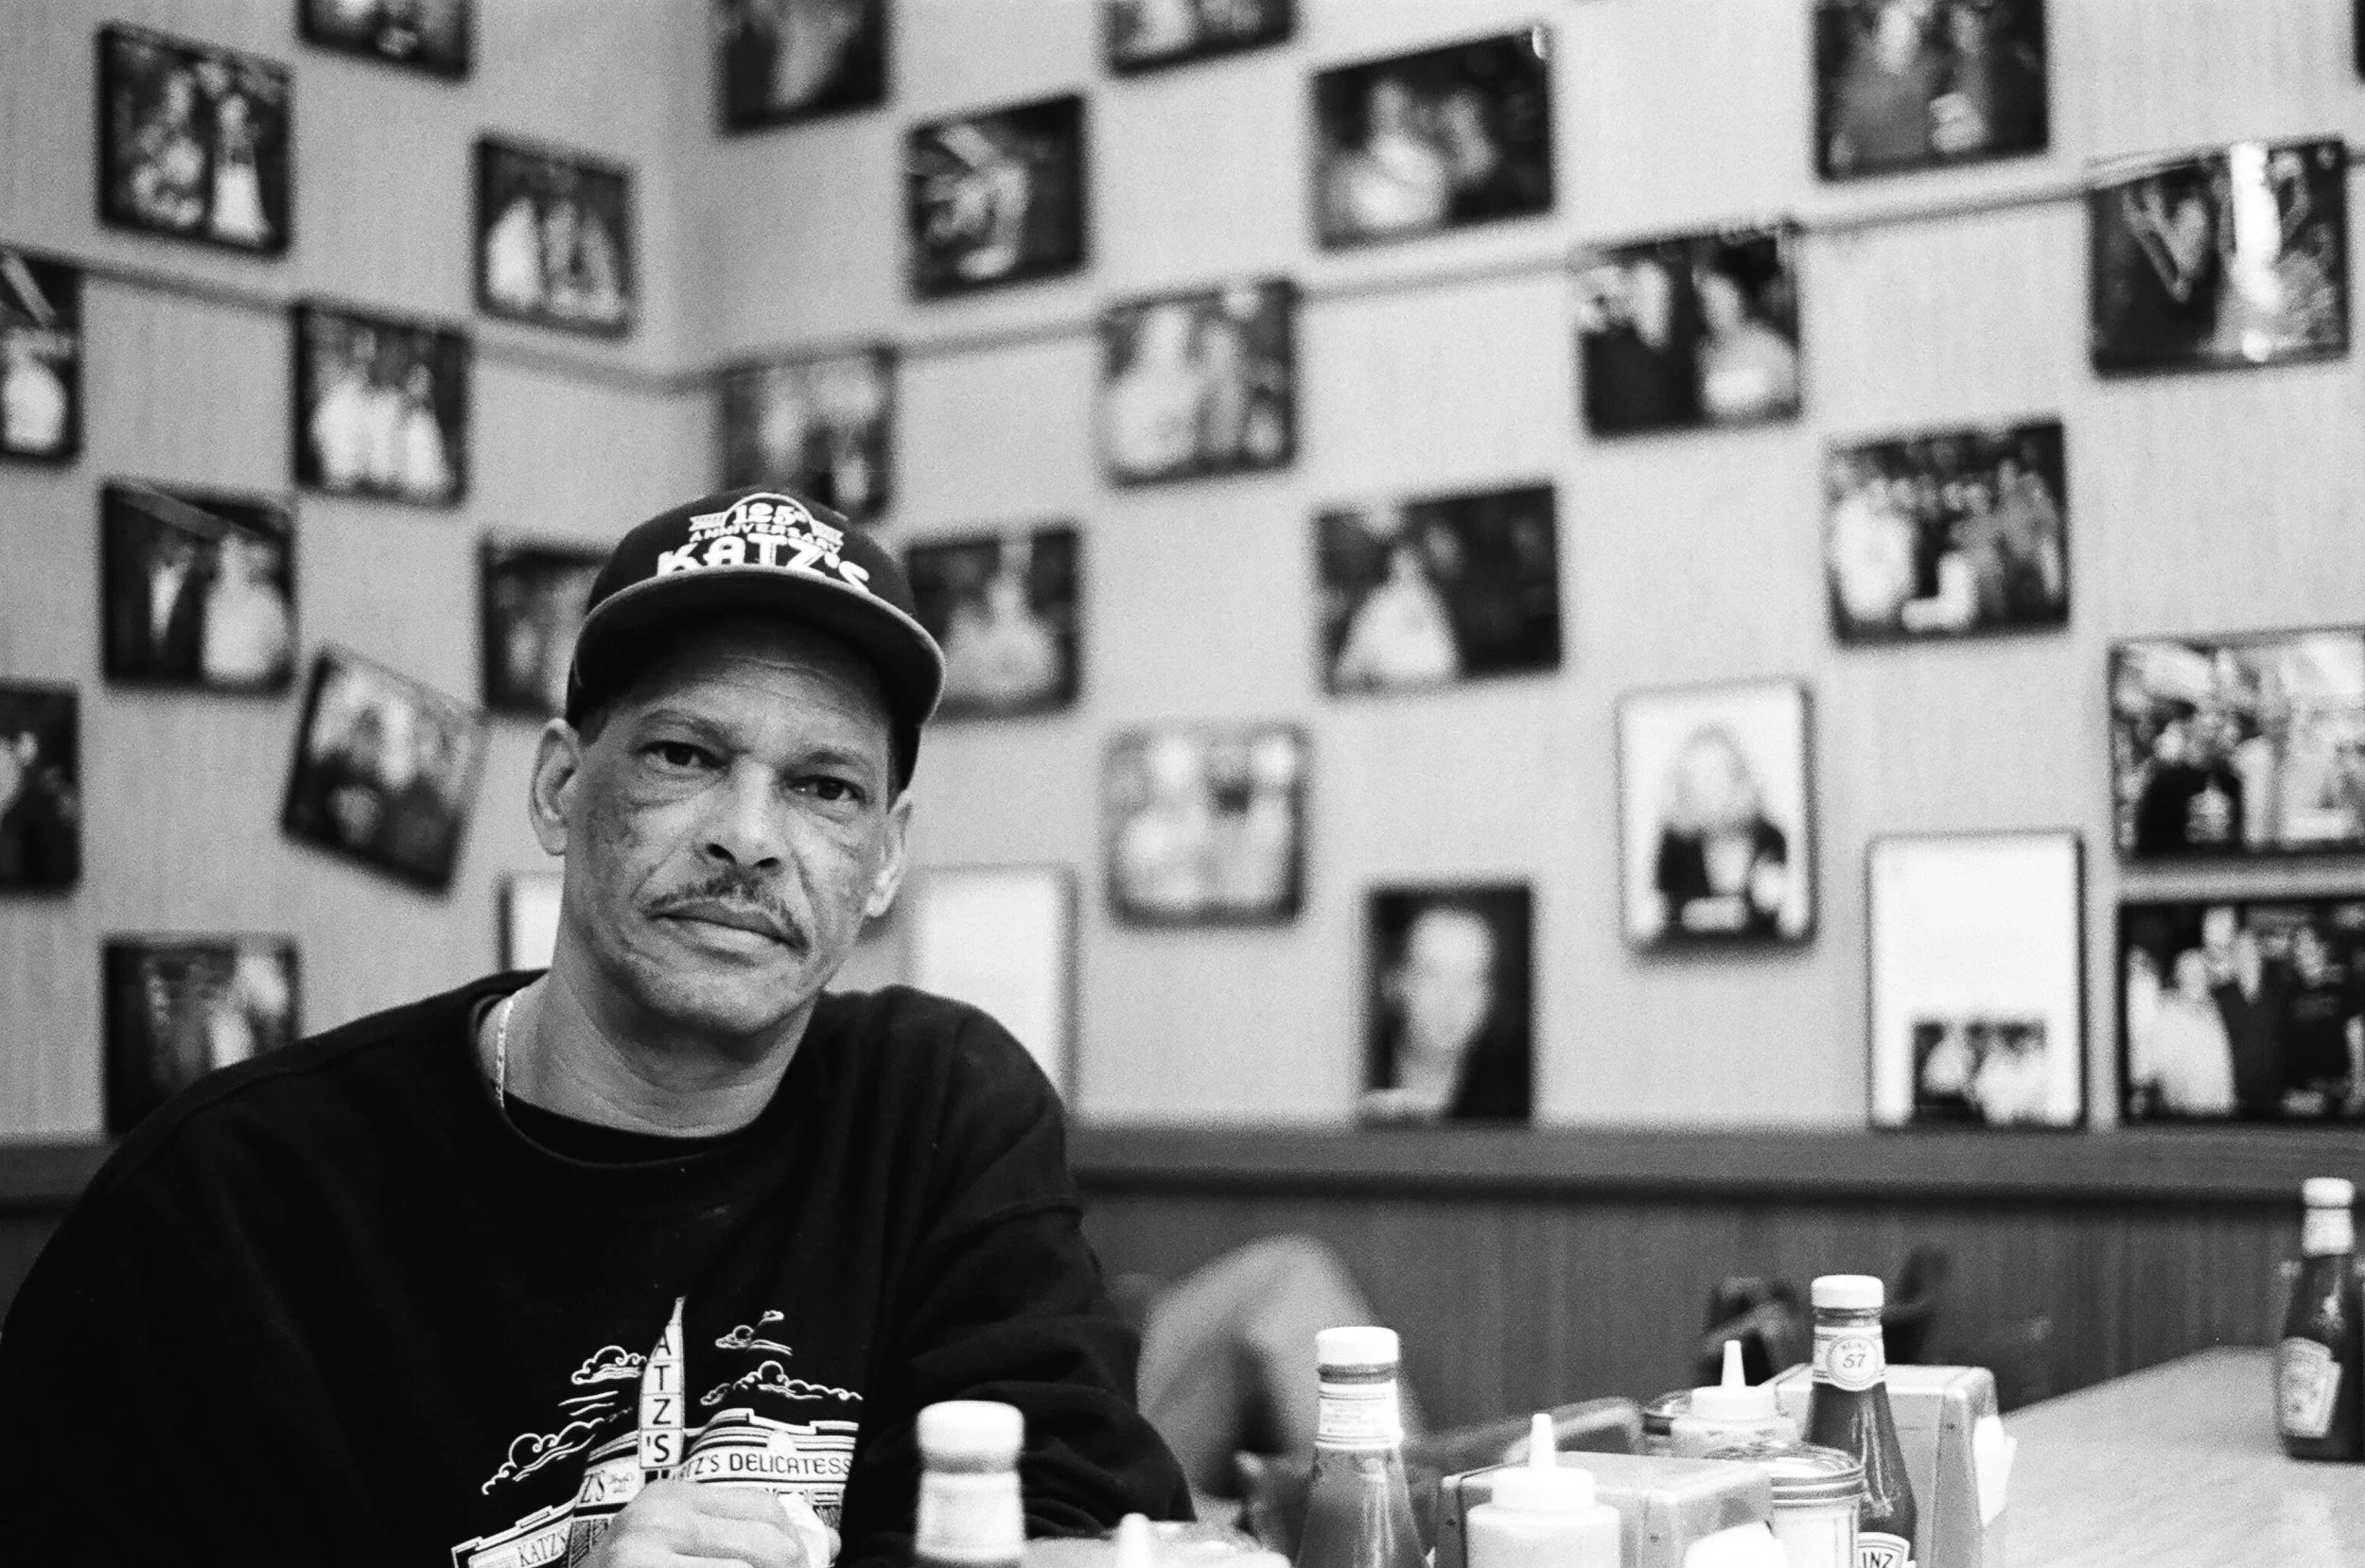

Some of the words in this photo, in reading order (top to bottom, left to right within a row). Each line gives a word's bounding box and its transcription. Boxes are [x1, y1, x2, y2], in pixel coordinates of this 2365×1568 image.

[689, 522, 842, 554] ANNIVERSARY
[657, 532, 870, 593] KATZ'S
[1843, 1354, 1866, 1368] 57
[1863, 1552, 1894, 1568] INZ
